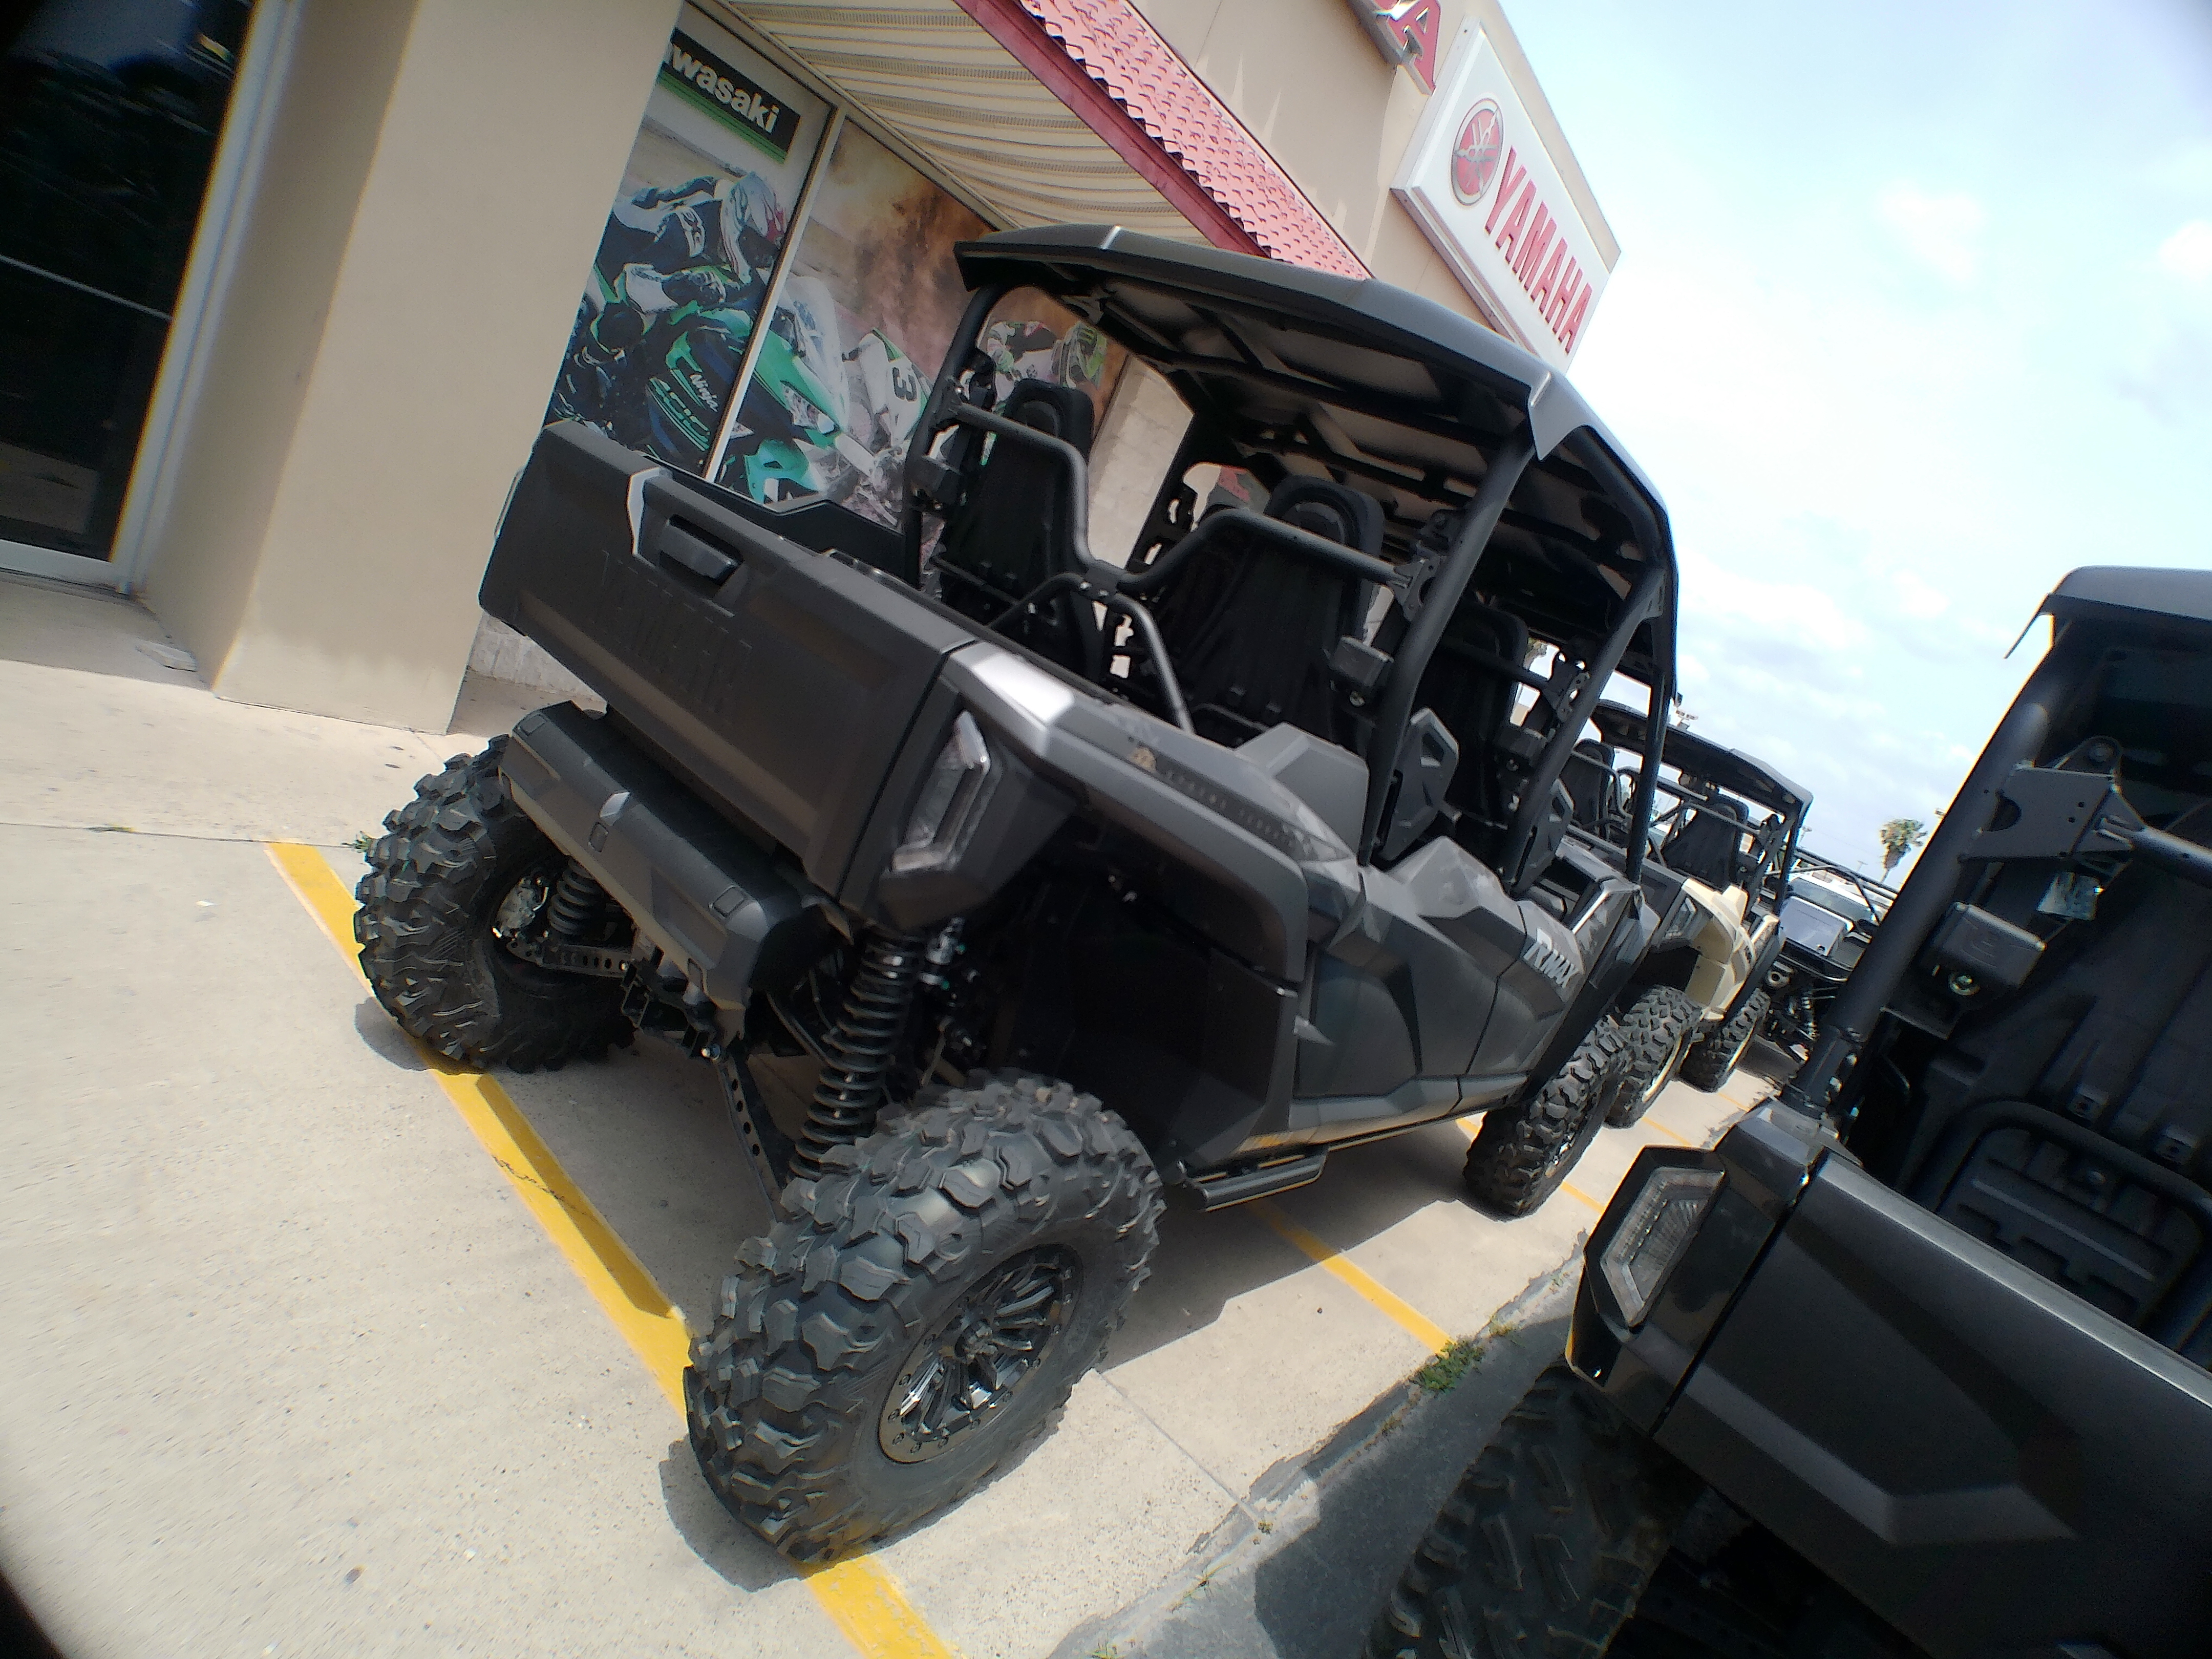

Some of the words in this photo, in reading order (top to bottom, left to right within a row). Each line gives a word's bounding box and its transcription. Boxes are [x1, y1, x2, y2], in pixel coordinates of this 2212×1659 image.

[672, 44, 780, 134] wasaki
[1484, 145, 1593, 356] YAMAHA
[690, 374, 718, 413] Ninja
[1523, 927, 1580, 989] RMAX
